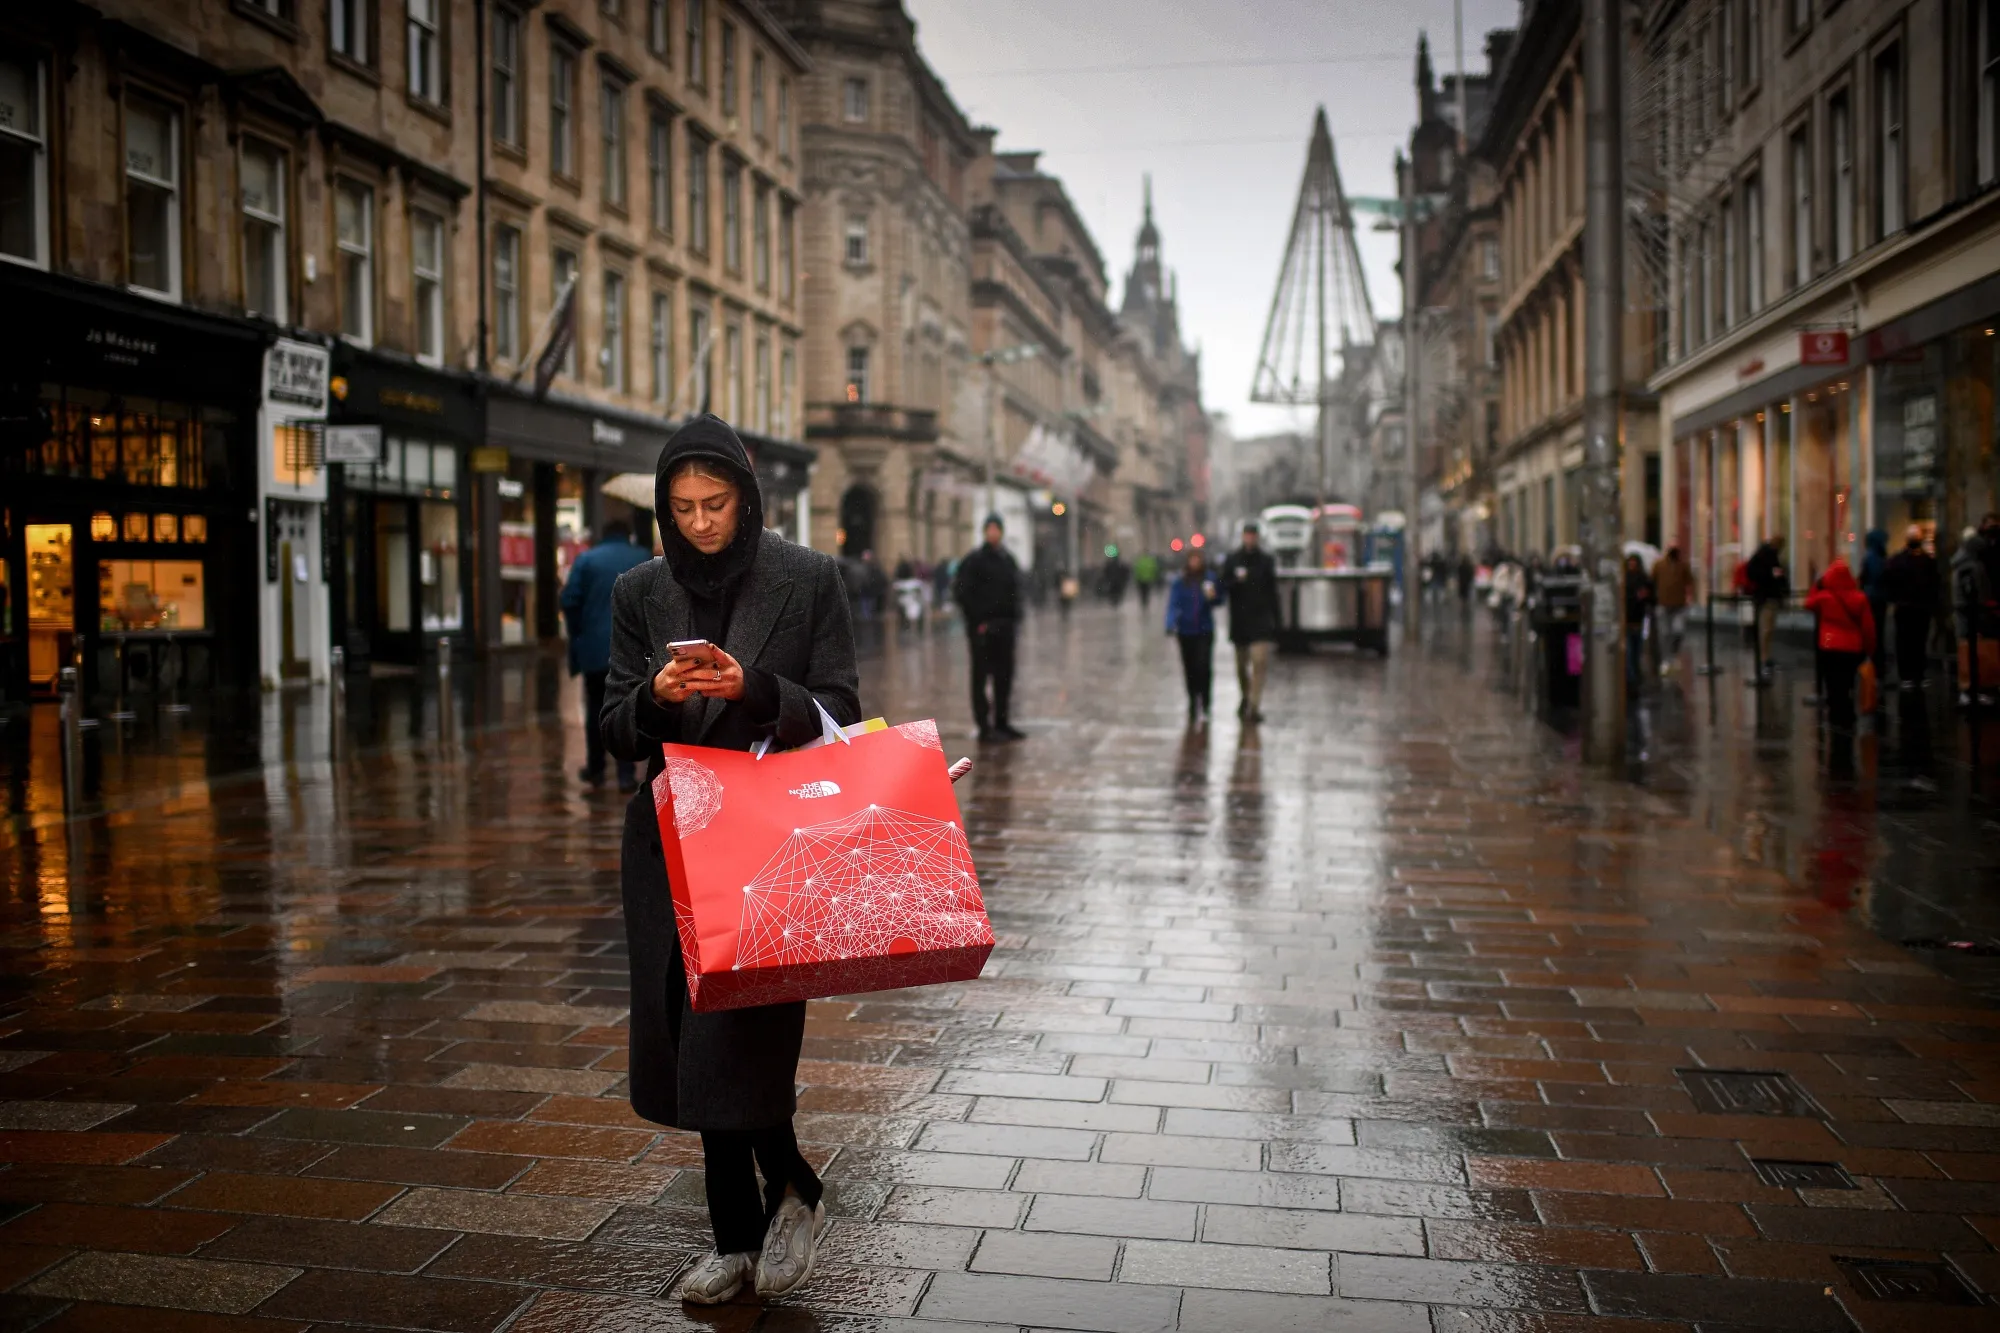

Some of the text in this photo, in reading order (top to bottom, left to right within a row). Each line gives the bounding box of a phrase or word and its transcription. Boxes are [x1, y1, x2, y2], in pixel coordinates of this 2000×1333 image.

[801, 782, 820, 790] THE
[788, 786, 822, 795] NORTH
[800, 791, 823, 799] FACE
